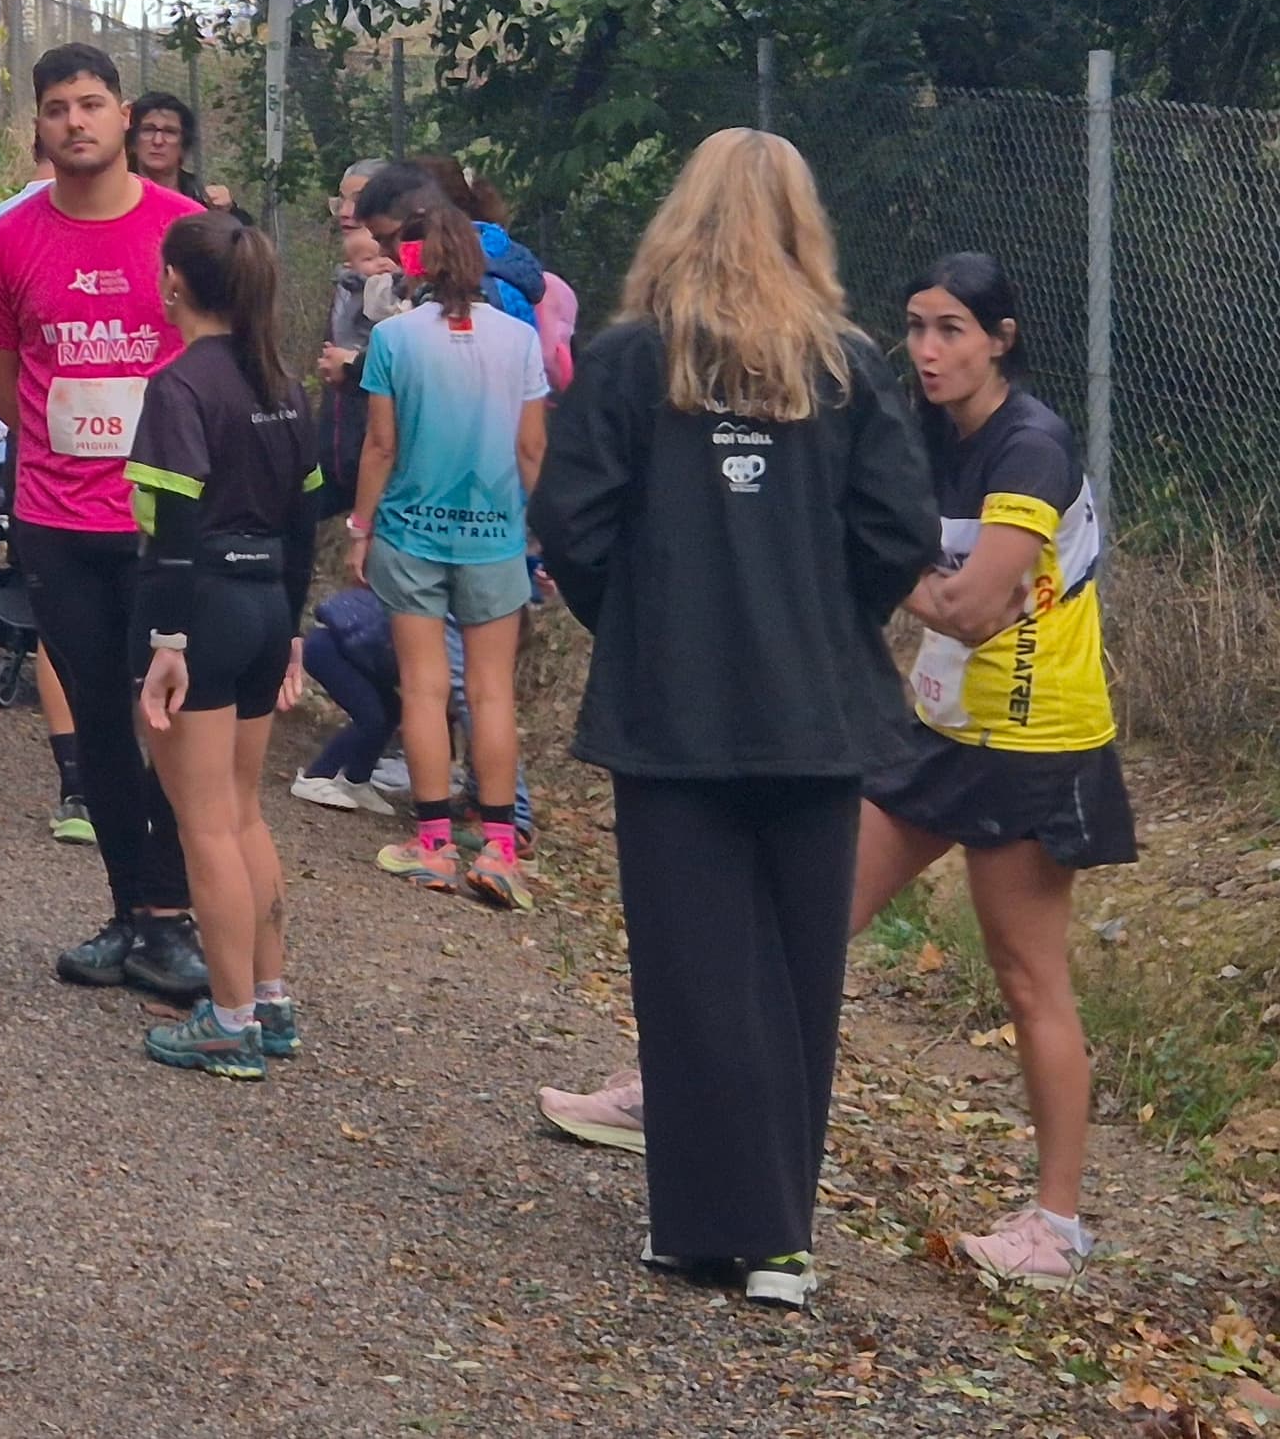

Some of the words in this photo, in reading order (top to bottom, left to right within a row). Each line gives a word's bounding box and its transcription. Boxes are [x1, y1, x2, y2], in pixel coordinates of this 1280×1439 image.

[56, 318, 128, 343] TRAIL
[57, 339, 160, 366] RAIMAT
[72, 416, 123, 436] 708
[459, 525, 508, 539] TRAIL
[1007, 617, 1039, 727] ALMATRET
[917, 671, 943, 703] 703
